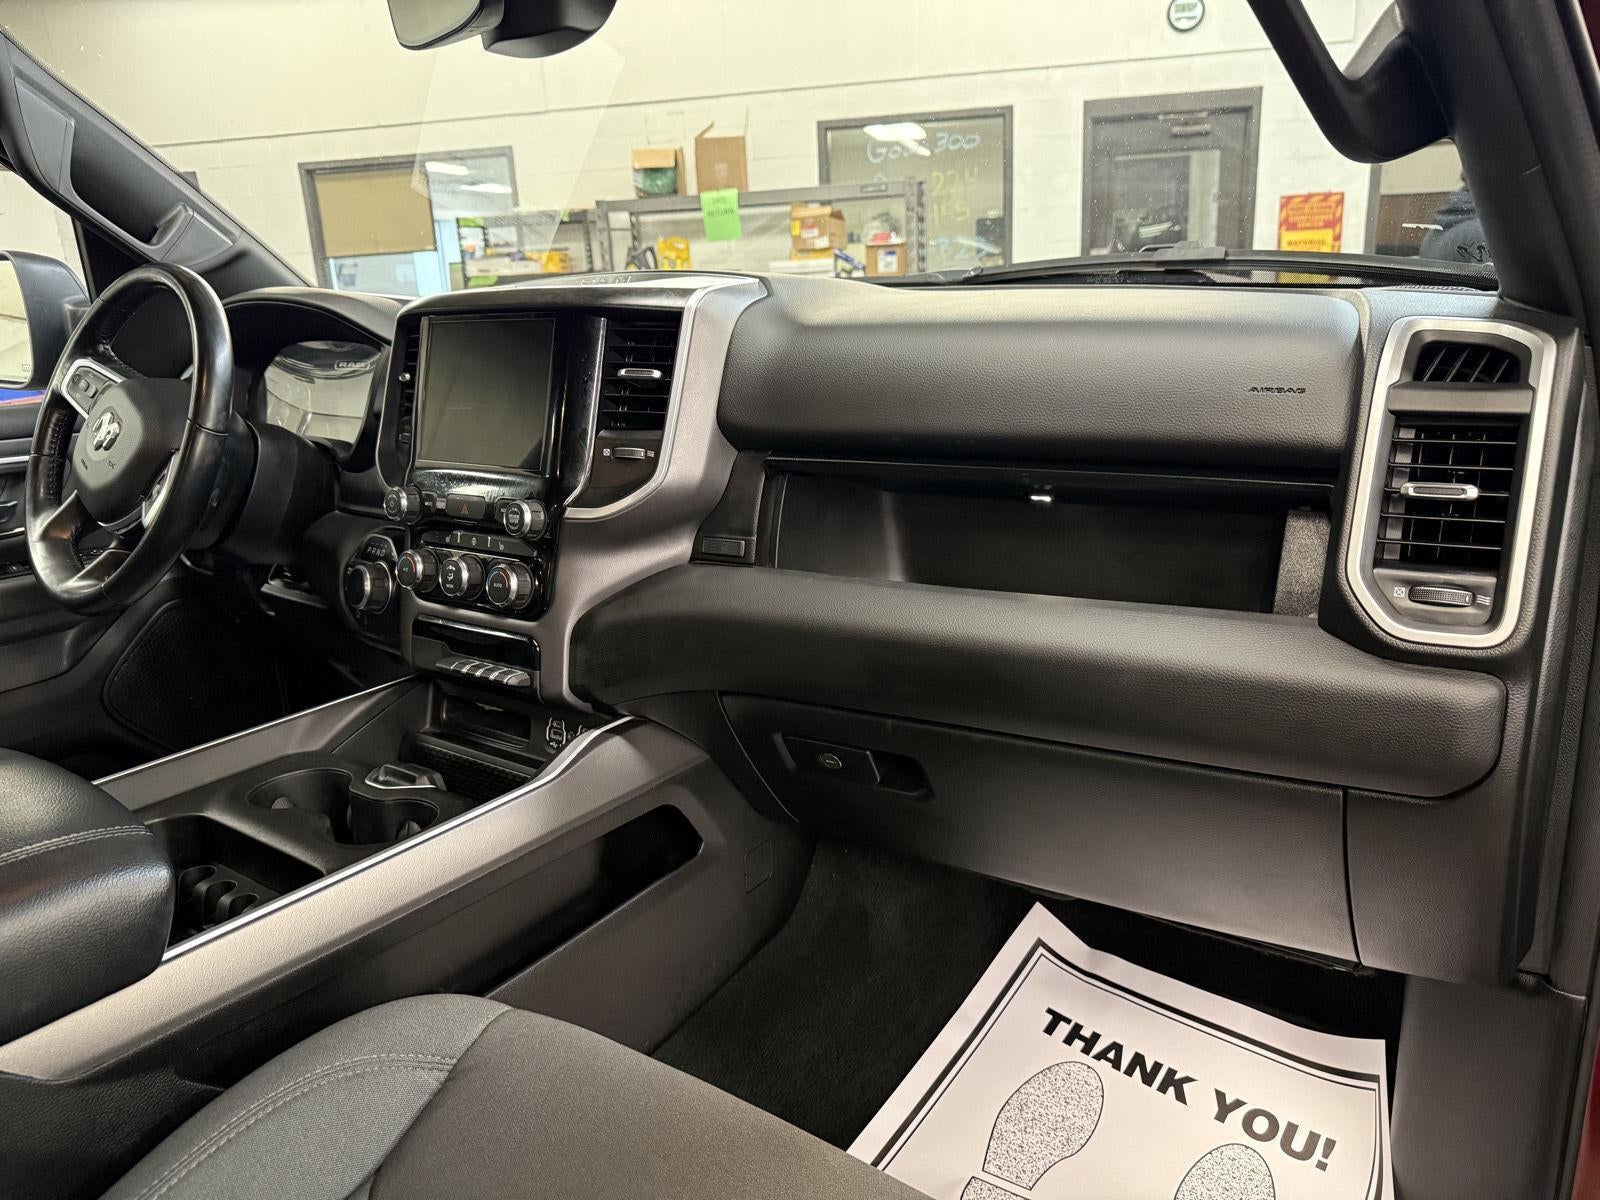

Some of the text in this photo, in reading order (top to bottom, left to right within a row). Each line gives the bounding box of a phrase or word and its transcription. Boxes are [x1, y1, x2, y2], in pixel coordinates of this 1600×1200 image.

[338, 361, 366, 369] RAM
[1248, 386, 1307, 395] AIRBAG
[1043, 1007, 1337, 1172] THANK YOU!
